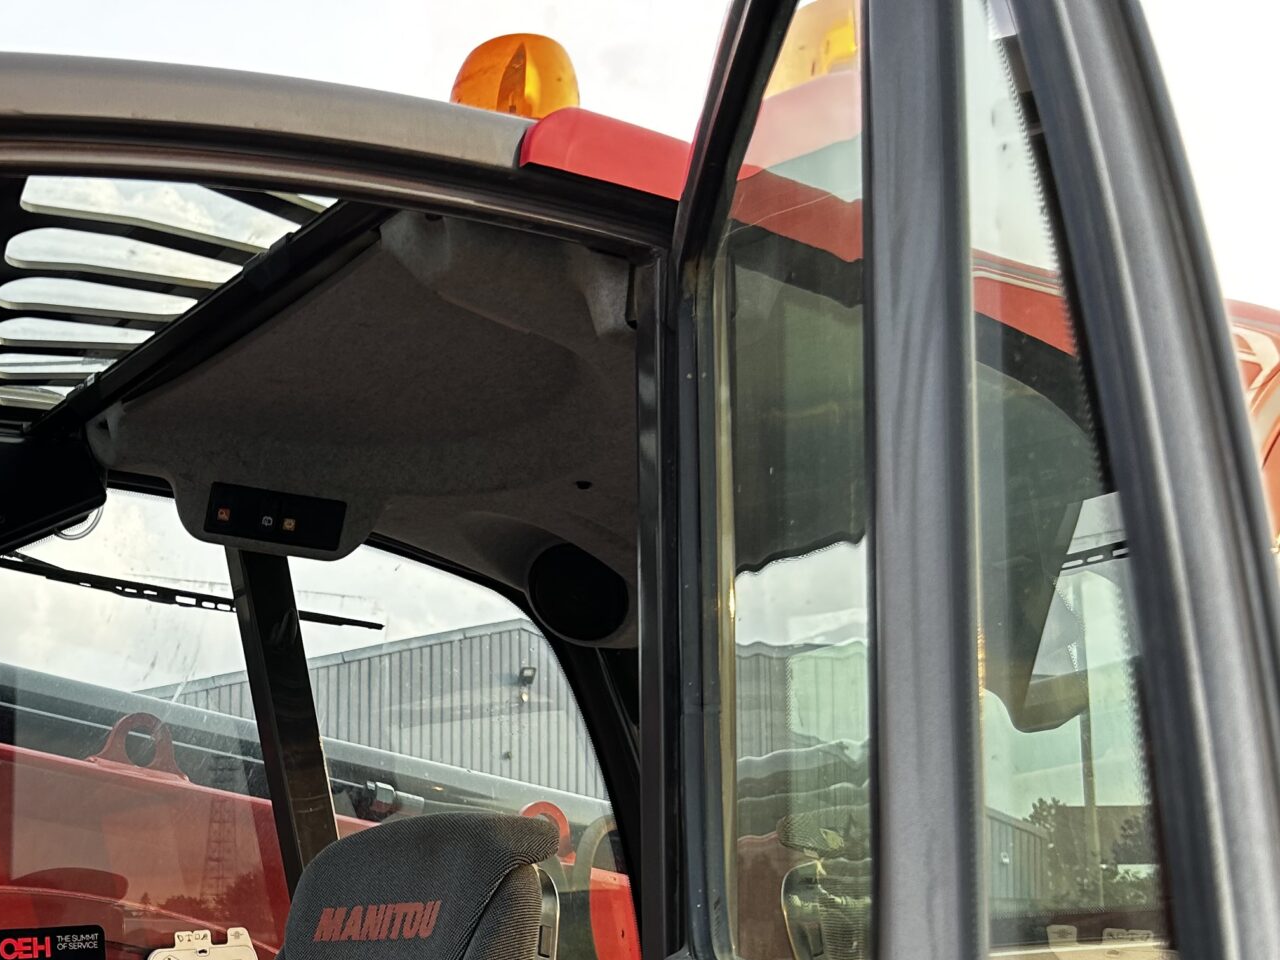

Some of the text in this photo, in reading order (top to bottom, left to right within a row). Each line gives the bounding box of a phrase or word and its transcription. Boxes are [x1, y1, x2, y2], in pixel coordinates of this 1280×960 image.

[313, 900, 442, 943] MANITOU
[72, 933, 99, 941] SUMMIT
[0, 936, 51, 960] OEH
[56, 941, 99, 951] OF SERVICE
